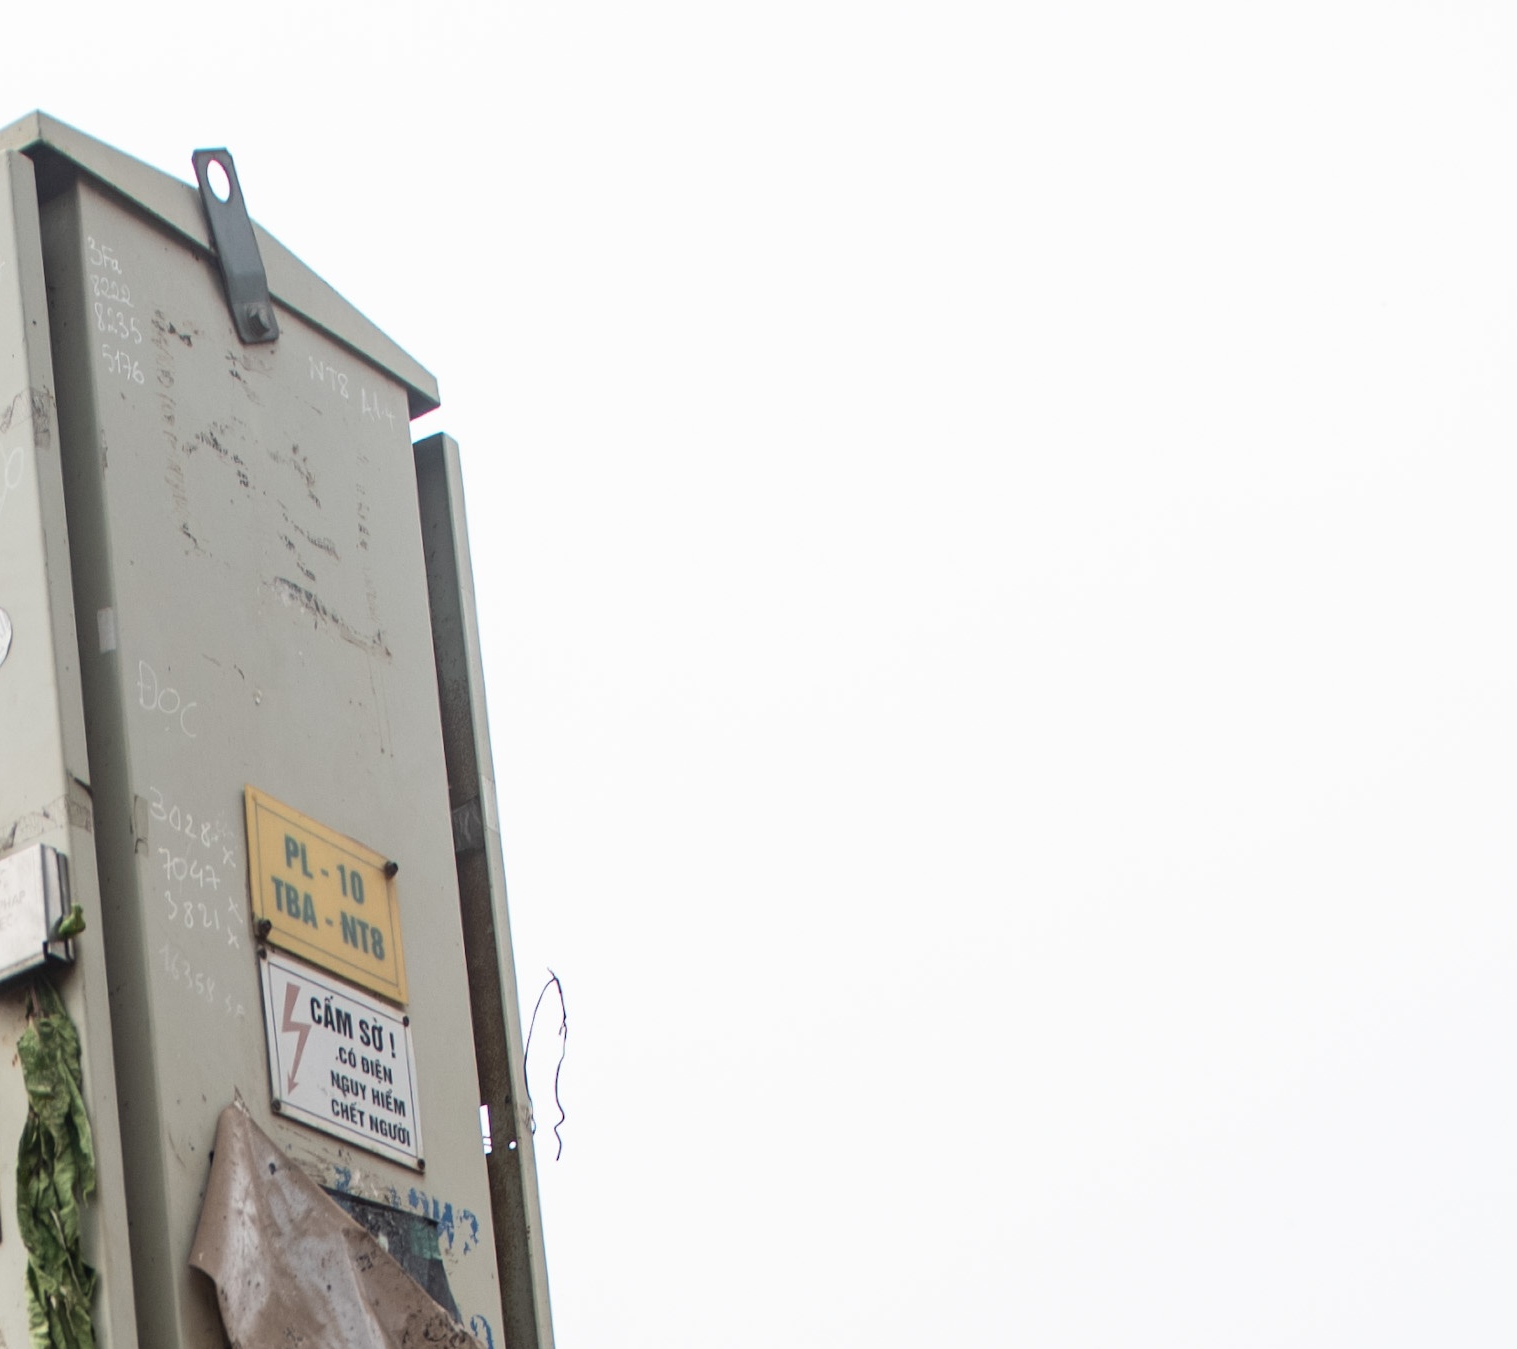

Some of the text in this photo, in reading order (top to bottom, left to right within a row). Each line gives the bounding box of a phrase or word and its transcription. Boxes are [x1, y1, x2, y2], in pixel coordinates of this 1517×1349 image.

[284, 832, 313, 880] PL
[337, 863, 366, 905] 10
[270, 874, 319, 931] TBA
[340, 910, 386, 961] NT8
[309, 995, 354, 1040] CẤM
[329, 1069, 367, 1101] NGUY
[330, 1098, 412, 1148] CHẾT NGƯỜI
